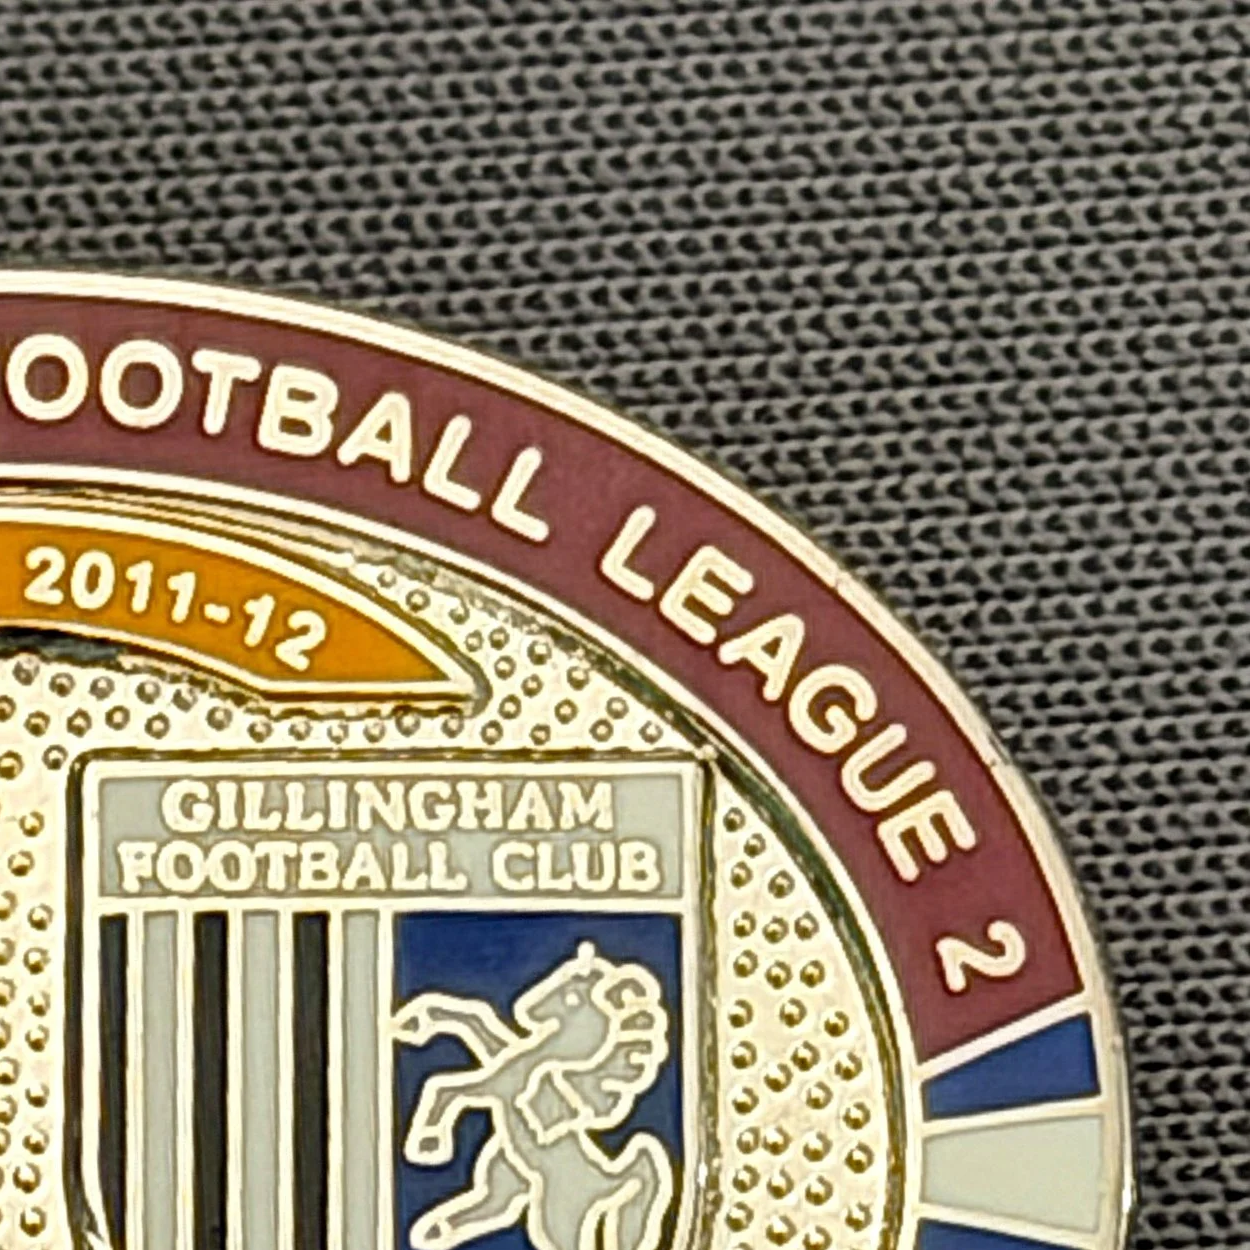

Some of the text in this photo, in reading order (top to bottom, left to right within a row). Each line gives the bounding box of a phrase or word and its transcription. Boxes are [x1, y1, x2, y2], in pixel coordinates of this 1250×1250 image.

[24, 546, 327, 670] 2011-12
[599, 505, 977, 883] LEAGUE
[936, 919, 1027, 993] 2
[161, 780, 614, 832] GILLINGHAM
[116, 840, 661, 893] FOOTBALL CLUB
